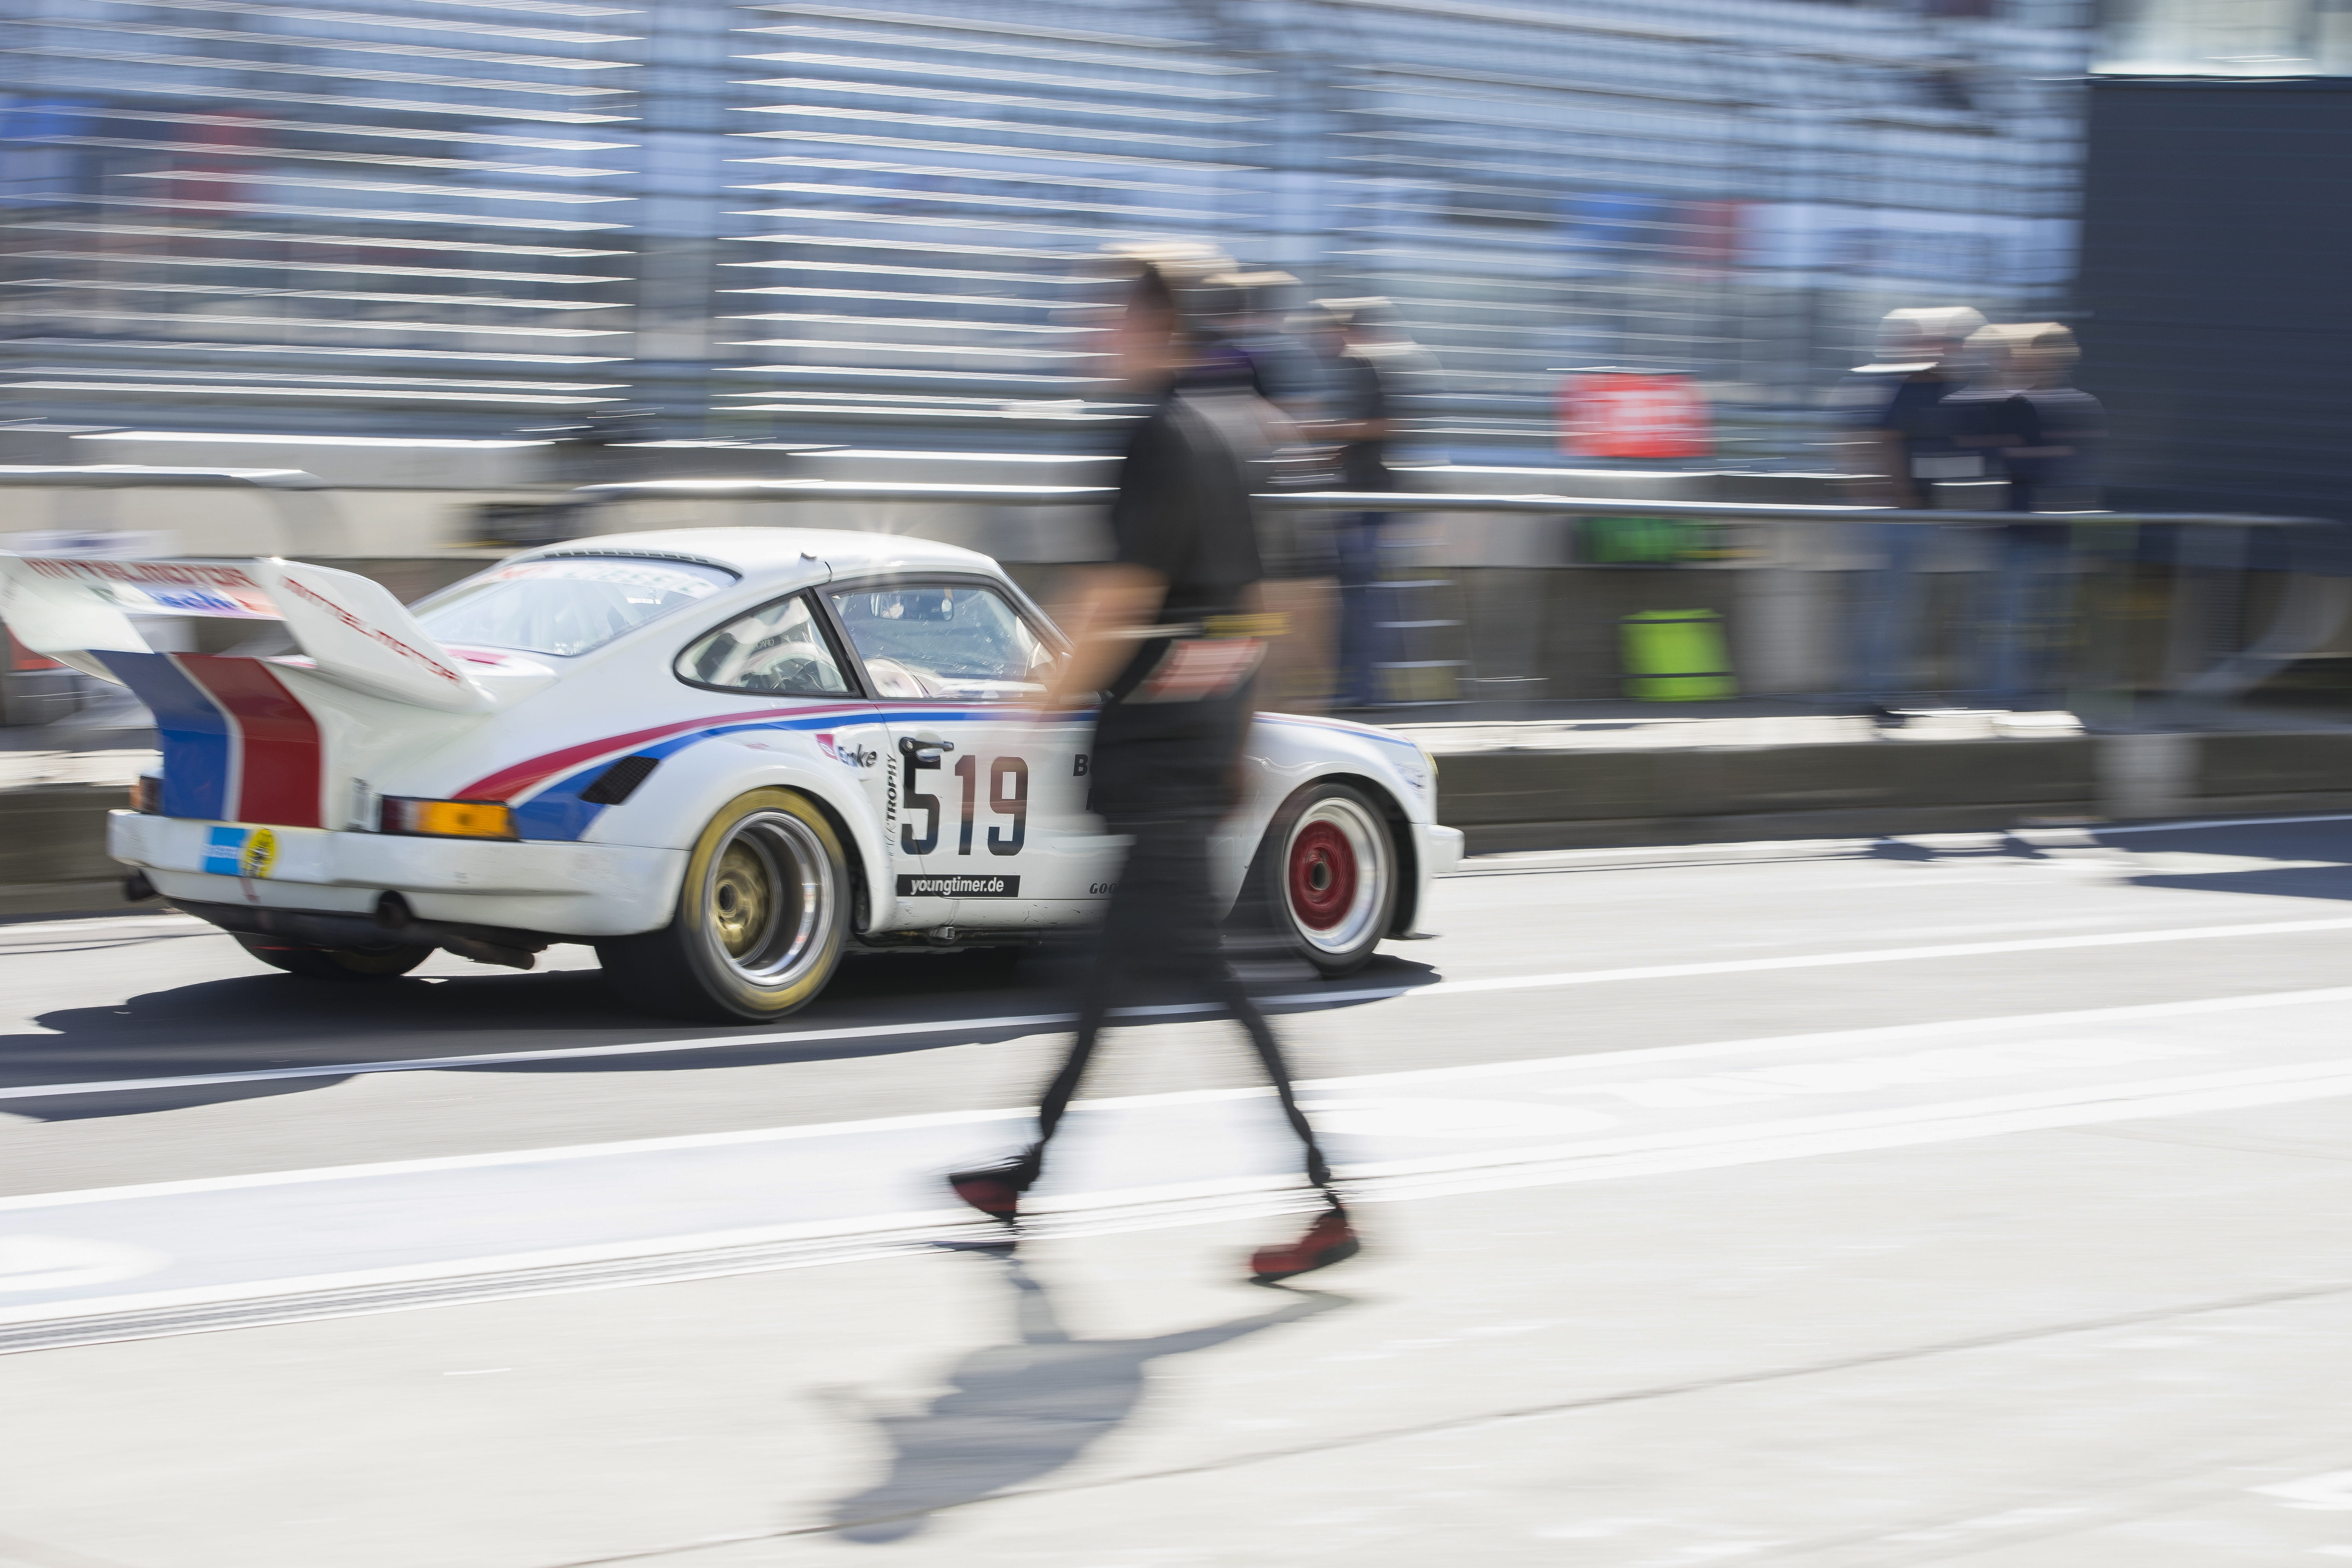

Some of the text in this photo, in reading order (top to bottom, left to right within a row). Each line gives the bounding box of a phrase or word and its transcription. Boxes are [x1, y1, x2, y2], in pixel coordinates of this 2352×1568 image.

[886, 753, 897, 822] TROPHY
[1073, 754, 1092, 777] B
[901, 755, 1028, 856] 519
[910, 877, 1004, 895] youngtimer.de
